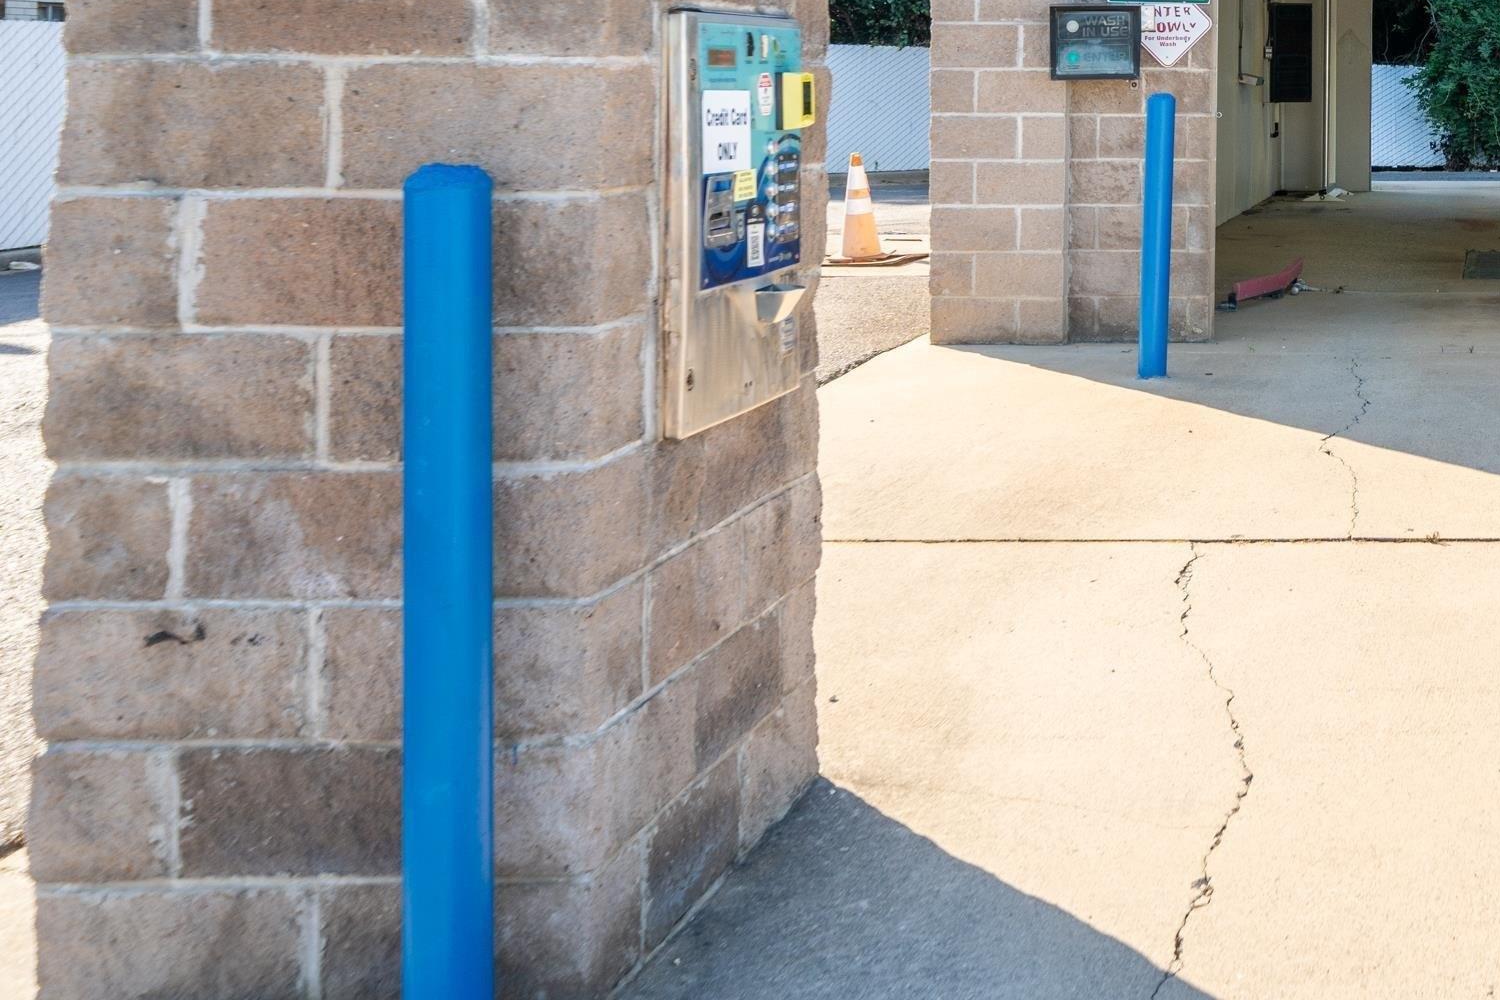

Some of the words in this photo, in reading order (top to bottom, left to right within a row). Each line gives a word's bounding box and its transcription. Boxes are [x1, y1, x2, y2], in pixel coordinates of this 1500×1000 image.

[1154, 6, 1191, 17] NTER
[1085, 15, 1125, 26] WASH
[1082, 26, 1096, 37] IN
[1100, 26, 1129, 37] USE
[1156, 21, 1196, 32] OWLY
[706, 108, 729, 127] Credit
[731, 108, 748, 126] Card
[717, 142, 738, 160] ONLY
